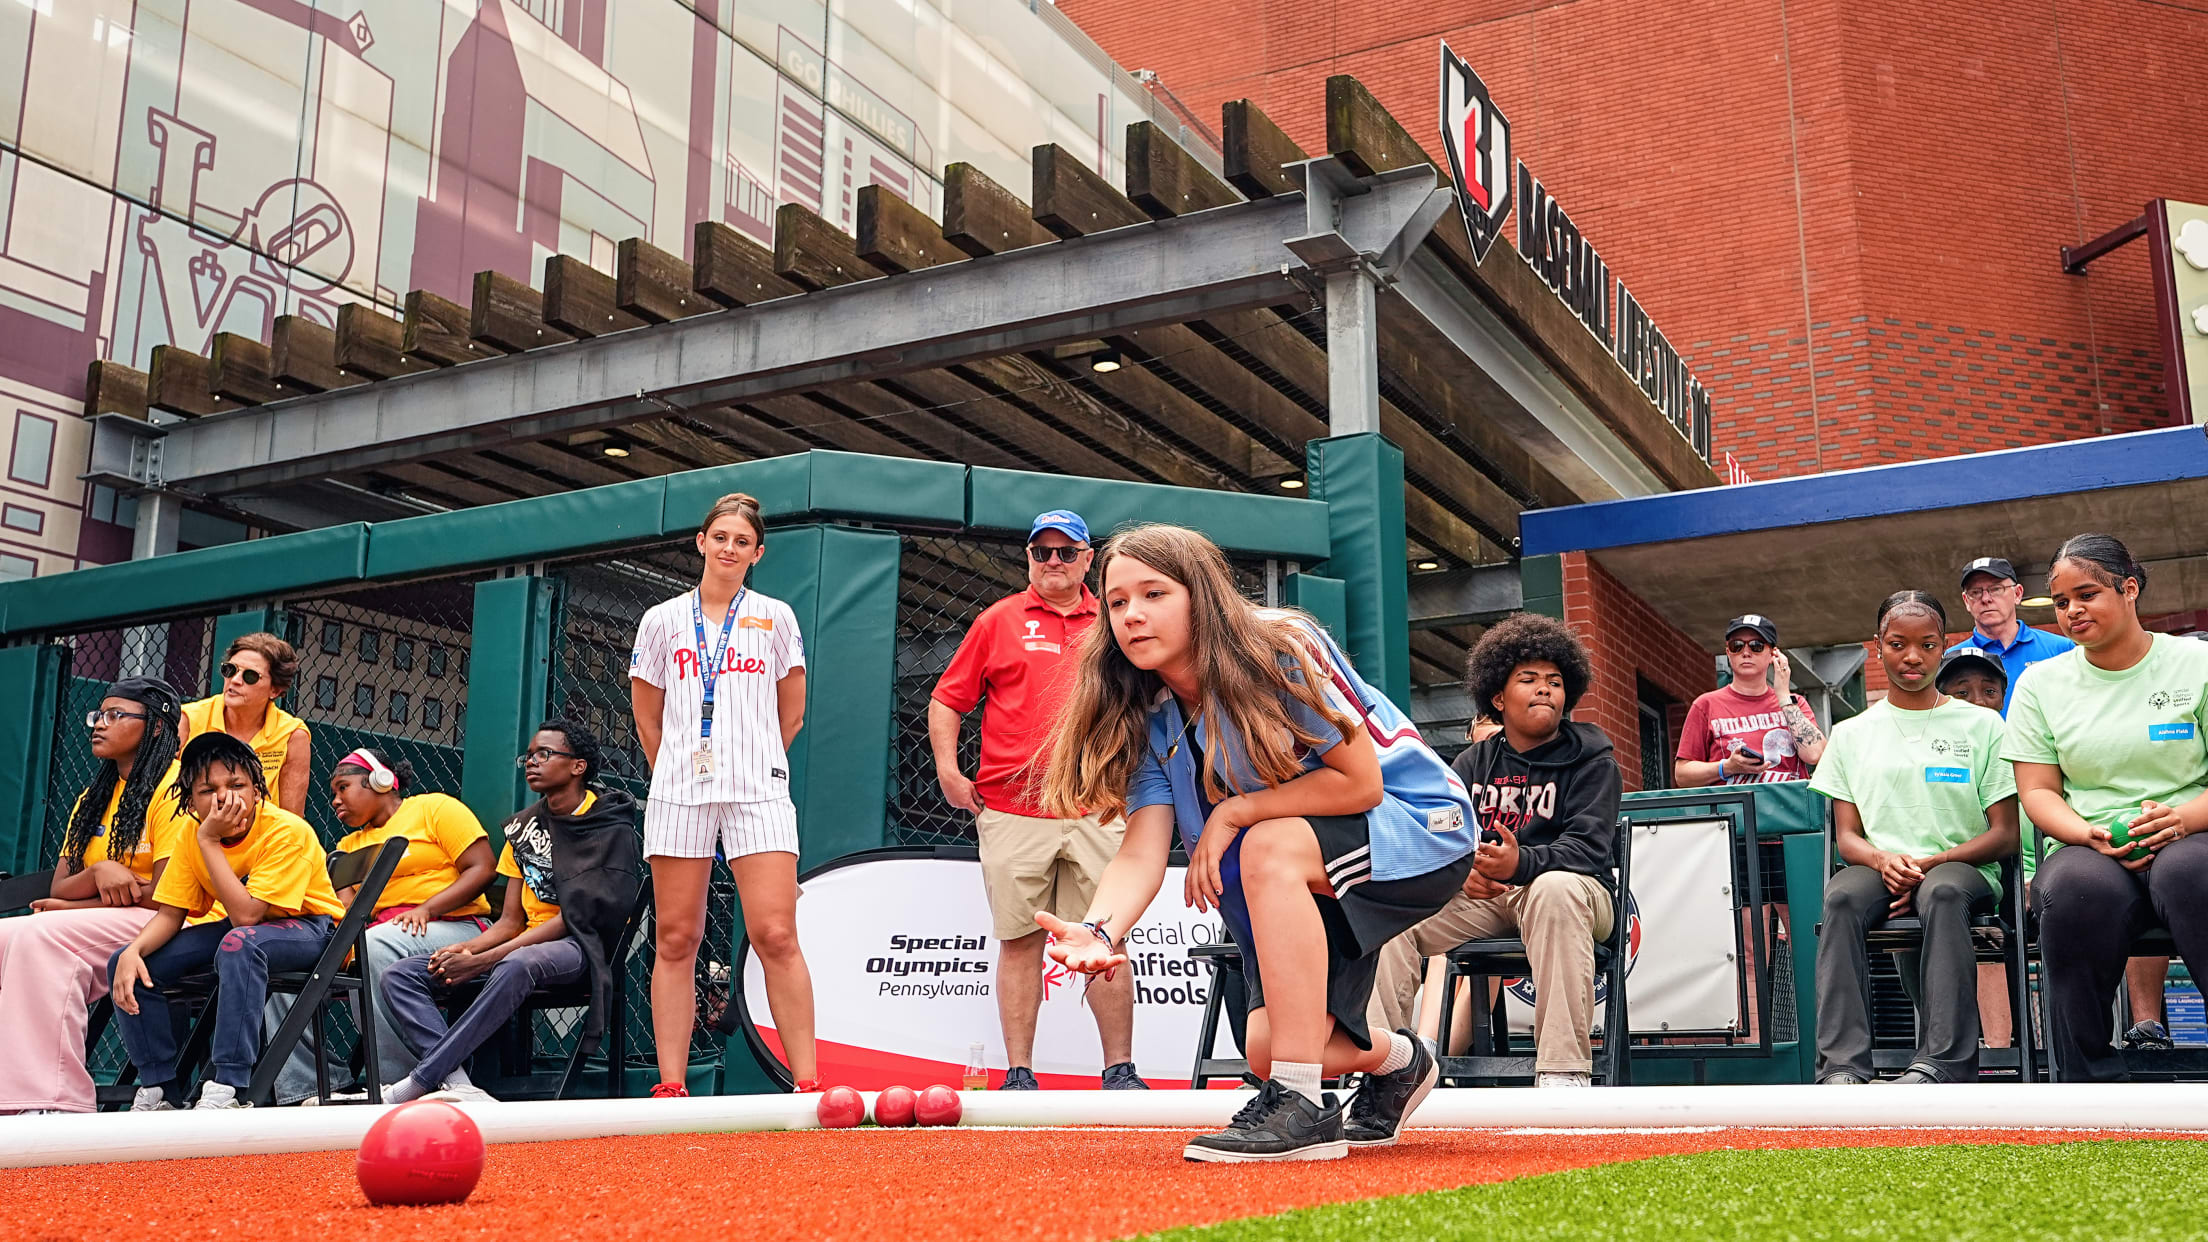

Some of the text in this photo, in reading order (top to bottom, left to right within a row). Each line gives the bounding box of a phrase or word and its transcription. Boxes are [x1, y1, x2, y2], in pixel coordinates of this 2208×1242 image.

[787, 50, 907, 151] GO PHILLIES
[1517, 157, 1614, 358] BASEBALL
[1615, 276, 1690, 445] LIFESTYLE
[889, 934, 987, 954] Special
[865, 957, 989, 976] Olympics
[878, 980, 990, 999] Pennsylvania
